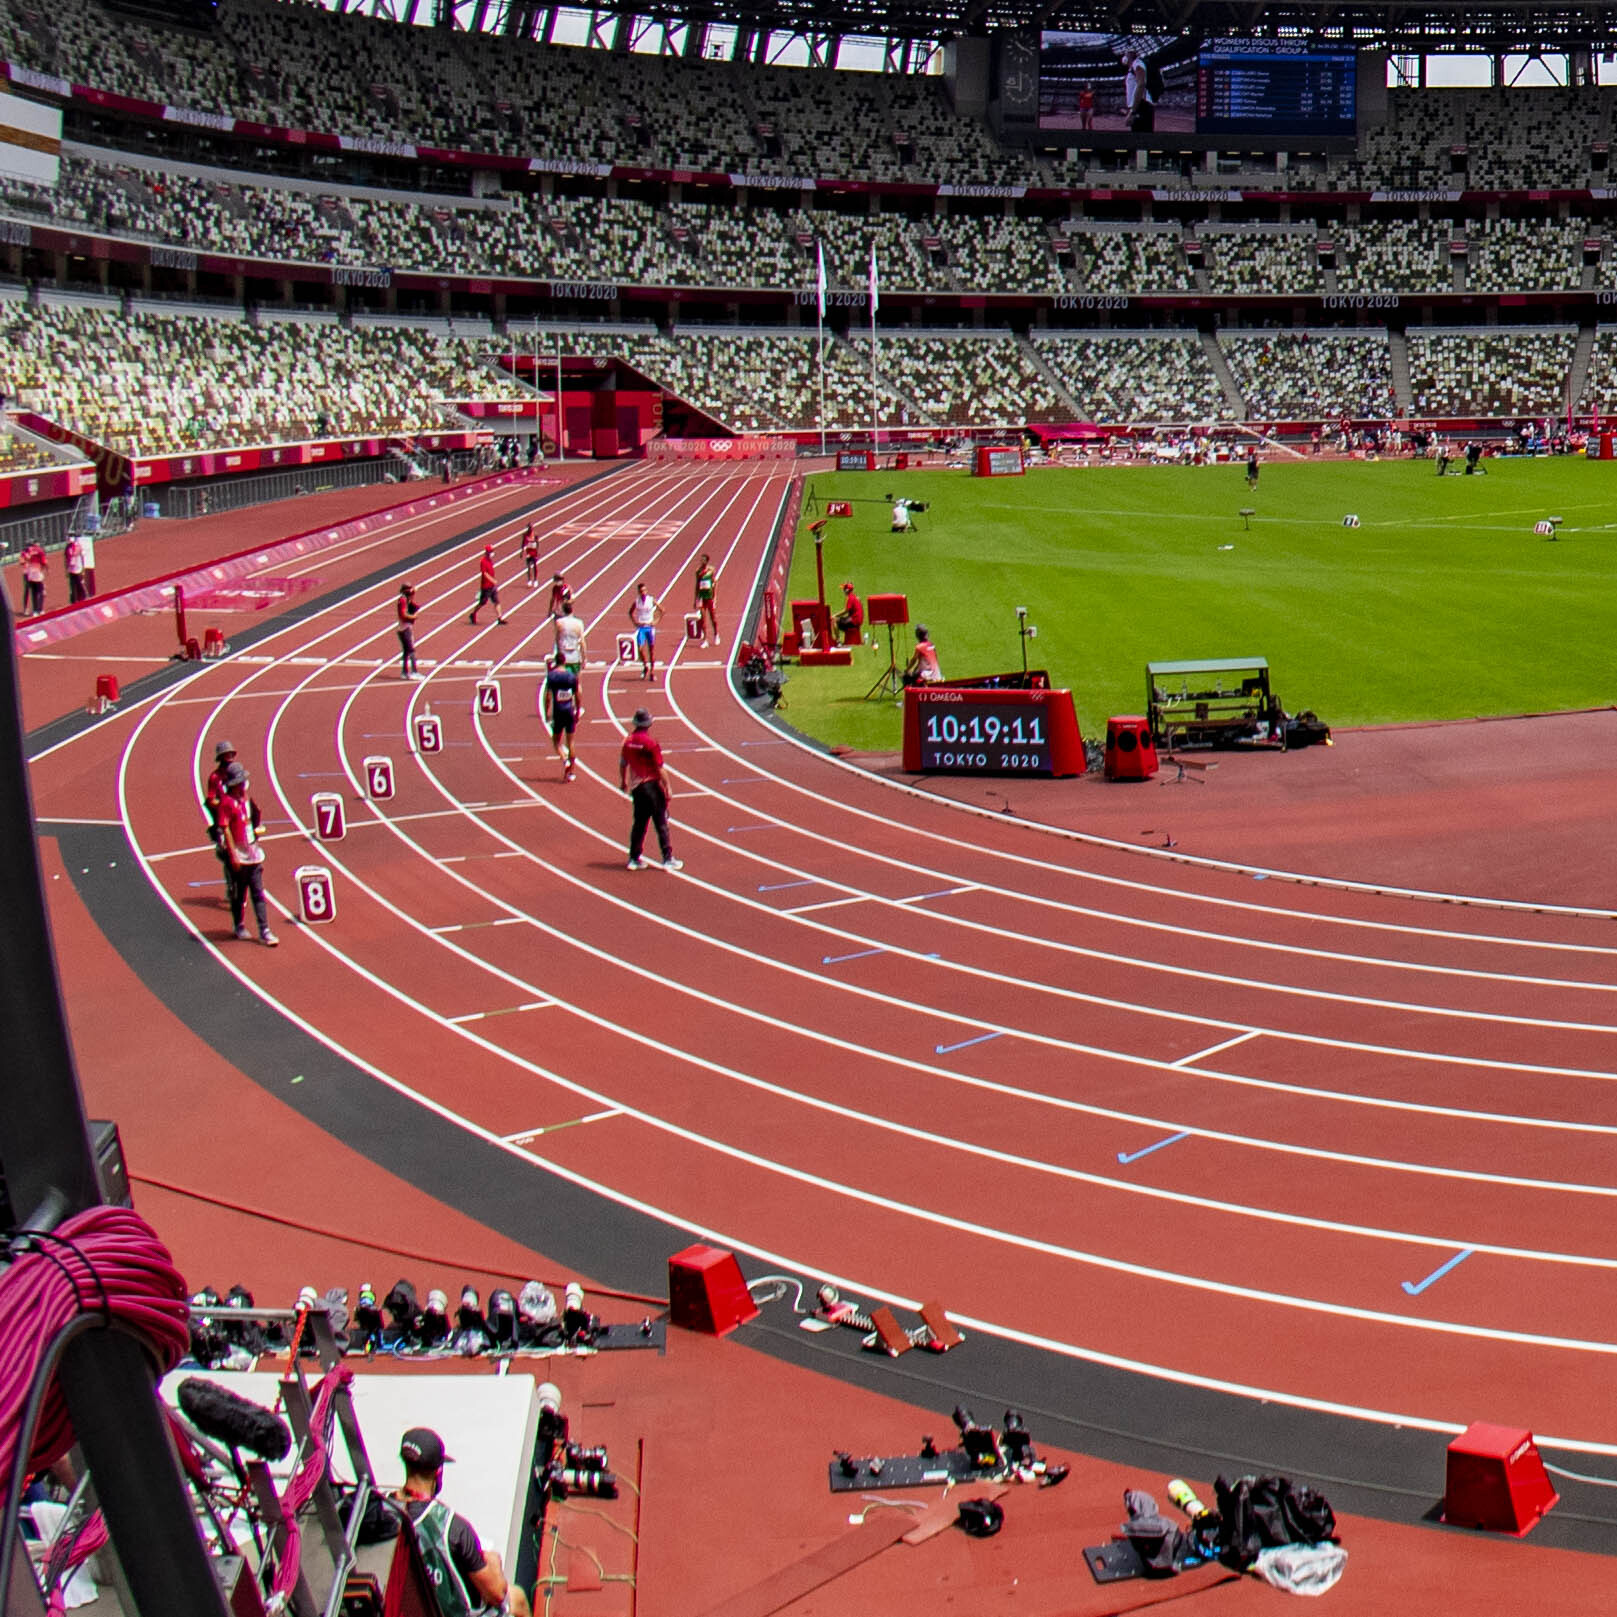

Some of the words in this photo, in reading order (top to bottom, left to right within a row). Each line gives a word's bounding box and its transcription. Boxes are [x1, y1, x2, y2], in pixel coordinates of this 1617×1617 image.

[352, 138, 381, 154] TOKYO
[383, 140, 405, 154] 2020
[543, 160, 572, 175] TOKYO
[574, 161, 599, 175] 2020
[744, 176, 776, 188] TOKYO
[778, 177, 803, 188] 2020
[952, 185, 983, 196] TOKYO
[986, 186, 1012, 196] 2020
[1167, 191, 1200, 201] TOKYO
[1202, 191, 1228, 201] 2020
[1384, 191, 1419, 201] TOKYO
[1421, 191, 1448, 201] 2020
[331, 268, 364, 287] TOKYO
[365, 271, 390, 288] 2020
[549, 283, 587, 299] TOKYO
[588, 284, 617, 299] 2020
[794, 292, 833, 305] TOKO
[835, 293, 866, 306] 2020
[1052, 296, 1094, 310] TOKYO
[1097, 296, 1128, 310] 2020
[1321, 296, 1364, 309] TOKYO
[1367, 296, 1399, 308] 2020
[648, 440, 681, 450] TOKYO
[682, 440, 706, 450] 2020
[737, 441, 768, 450] TOKYO
[771, 440, 796, 450] 2020
[690, 620, 698, 635] 1
[623, 642, 632, 657] 2
[483, 692, 495, 710] 4
[930, 693, 963, 702] OMEGA
[928, 714, 1045, 744] 10:19:11
[423, 728, 435, 747] 5
[934, 752, 986, 766] TOKYO
[1002, 755, 1039, 768] 2020
[373, 768, 387, 793] 6
[321, 806, 335, 834] 7
[308, 882, 326, 914] 8
